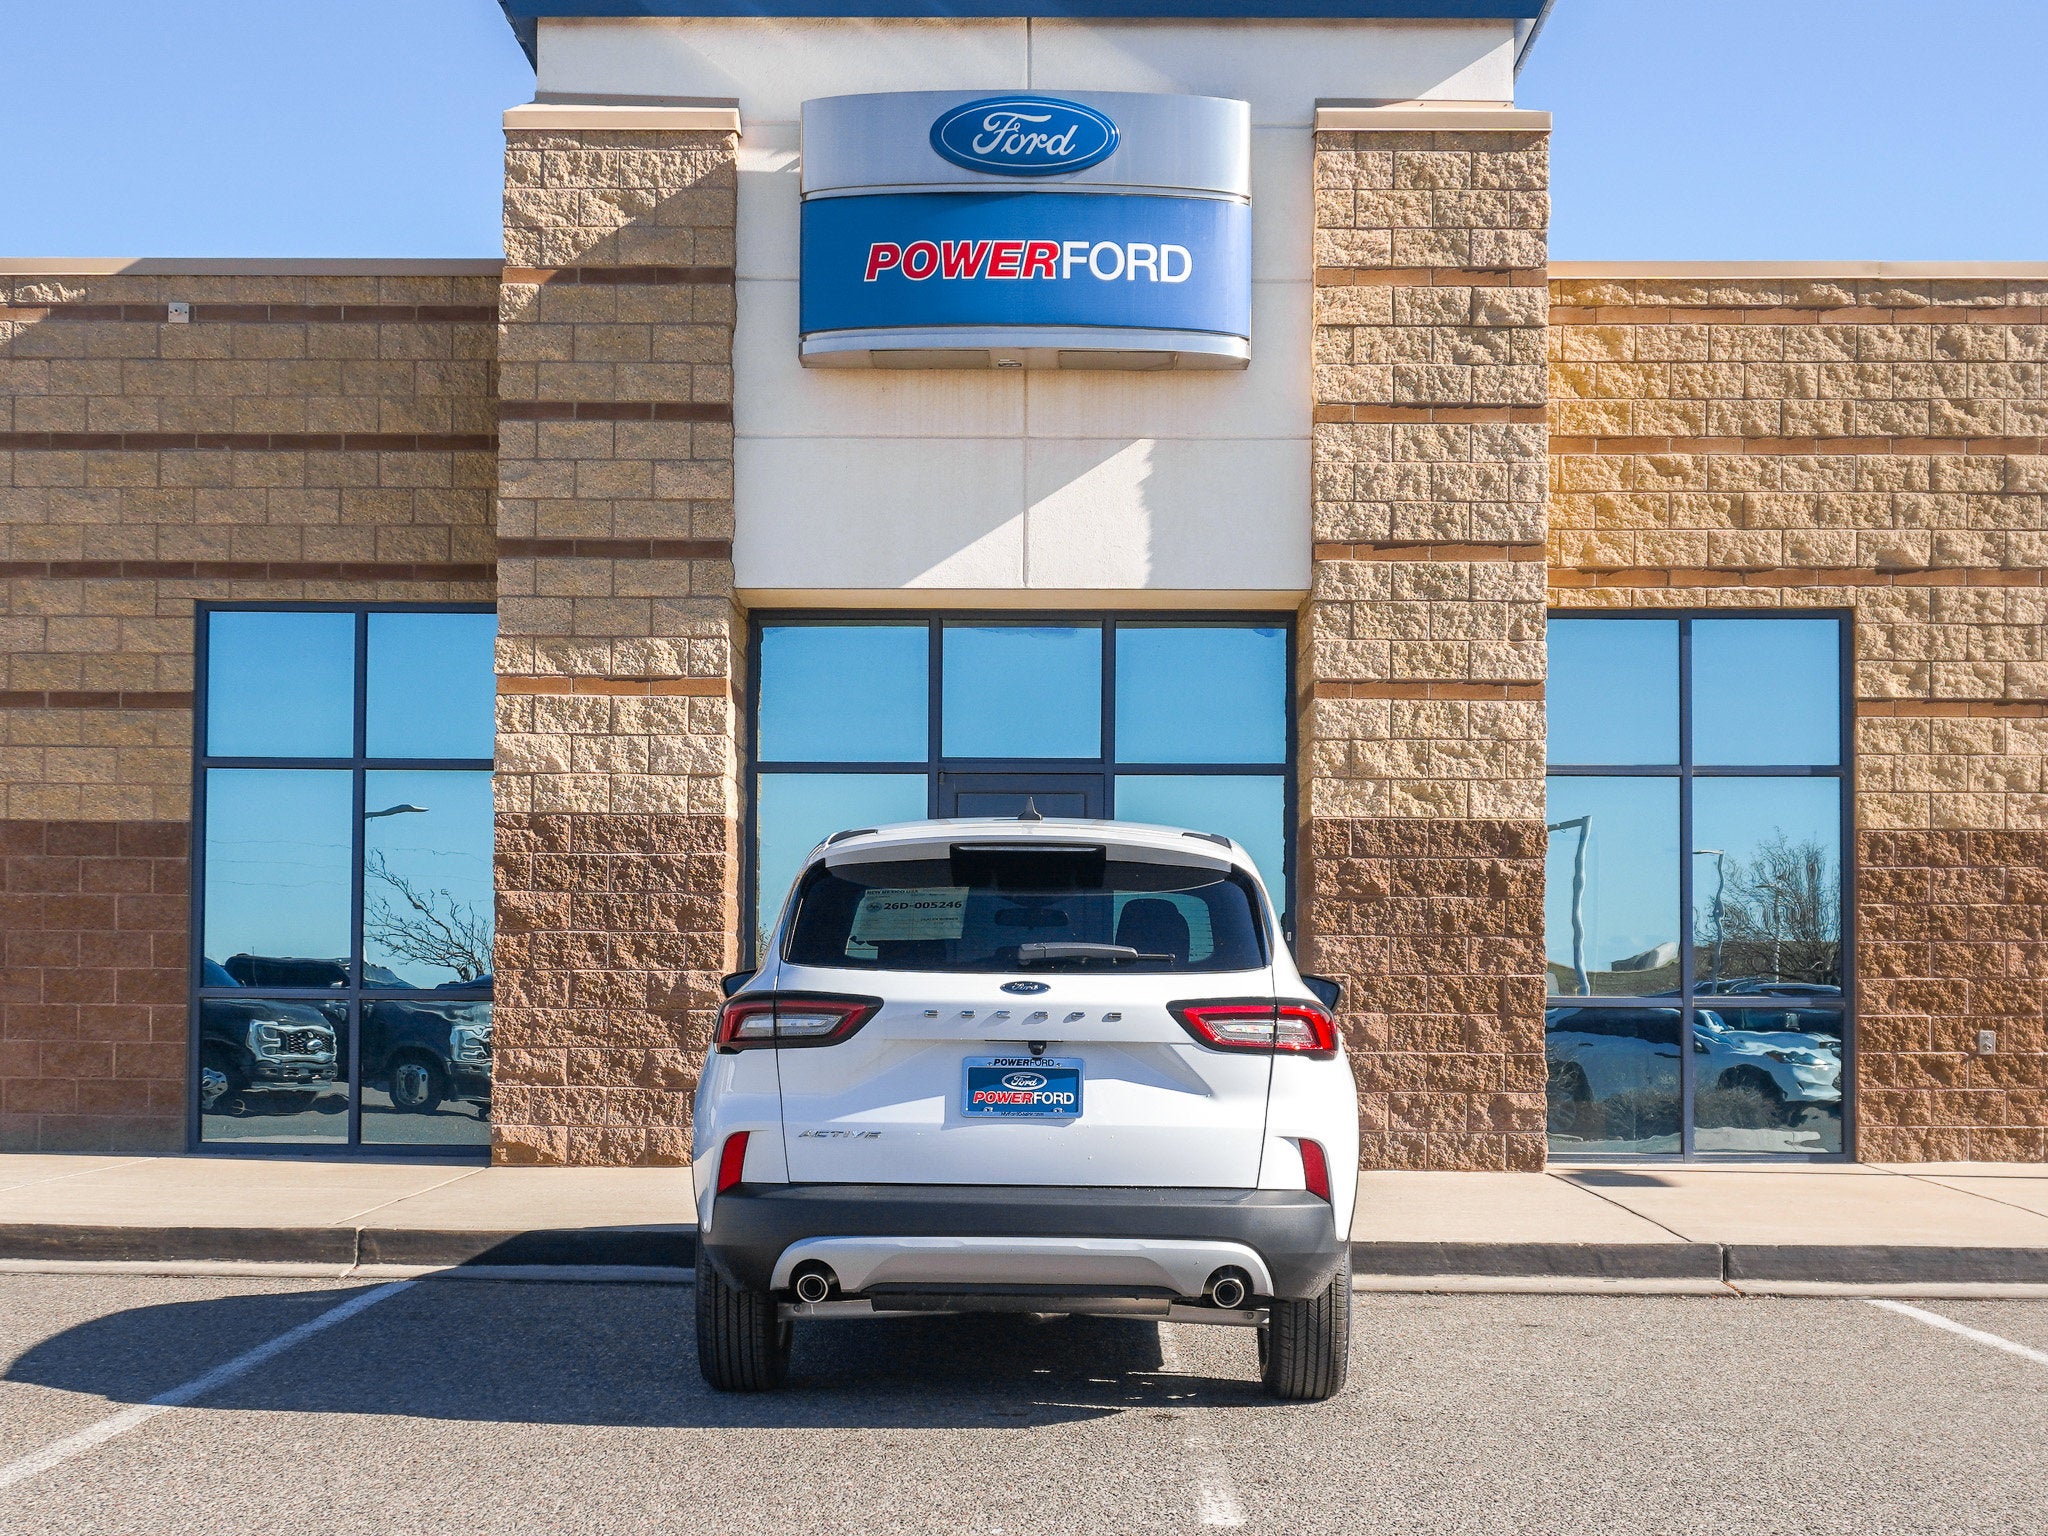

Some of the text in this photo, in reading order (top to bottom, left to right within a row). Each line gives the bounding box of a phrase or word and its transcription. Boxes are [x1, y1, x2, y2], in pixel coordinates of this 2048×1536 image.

[972, 111, 1078, 156] Ford
[864, 239, 1193, 284] POWERFORD
[884, 901, 962, 910] 26D-005246
[924, 1010, 1122, 1020] ESCAPE
[1010, 1074, 1038, 1087] Ford
[973, 1091, 1075, 1105] POWERFORD
[798, 1130, 881, 1138] ACTIVE
